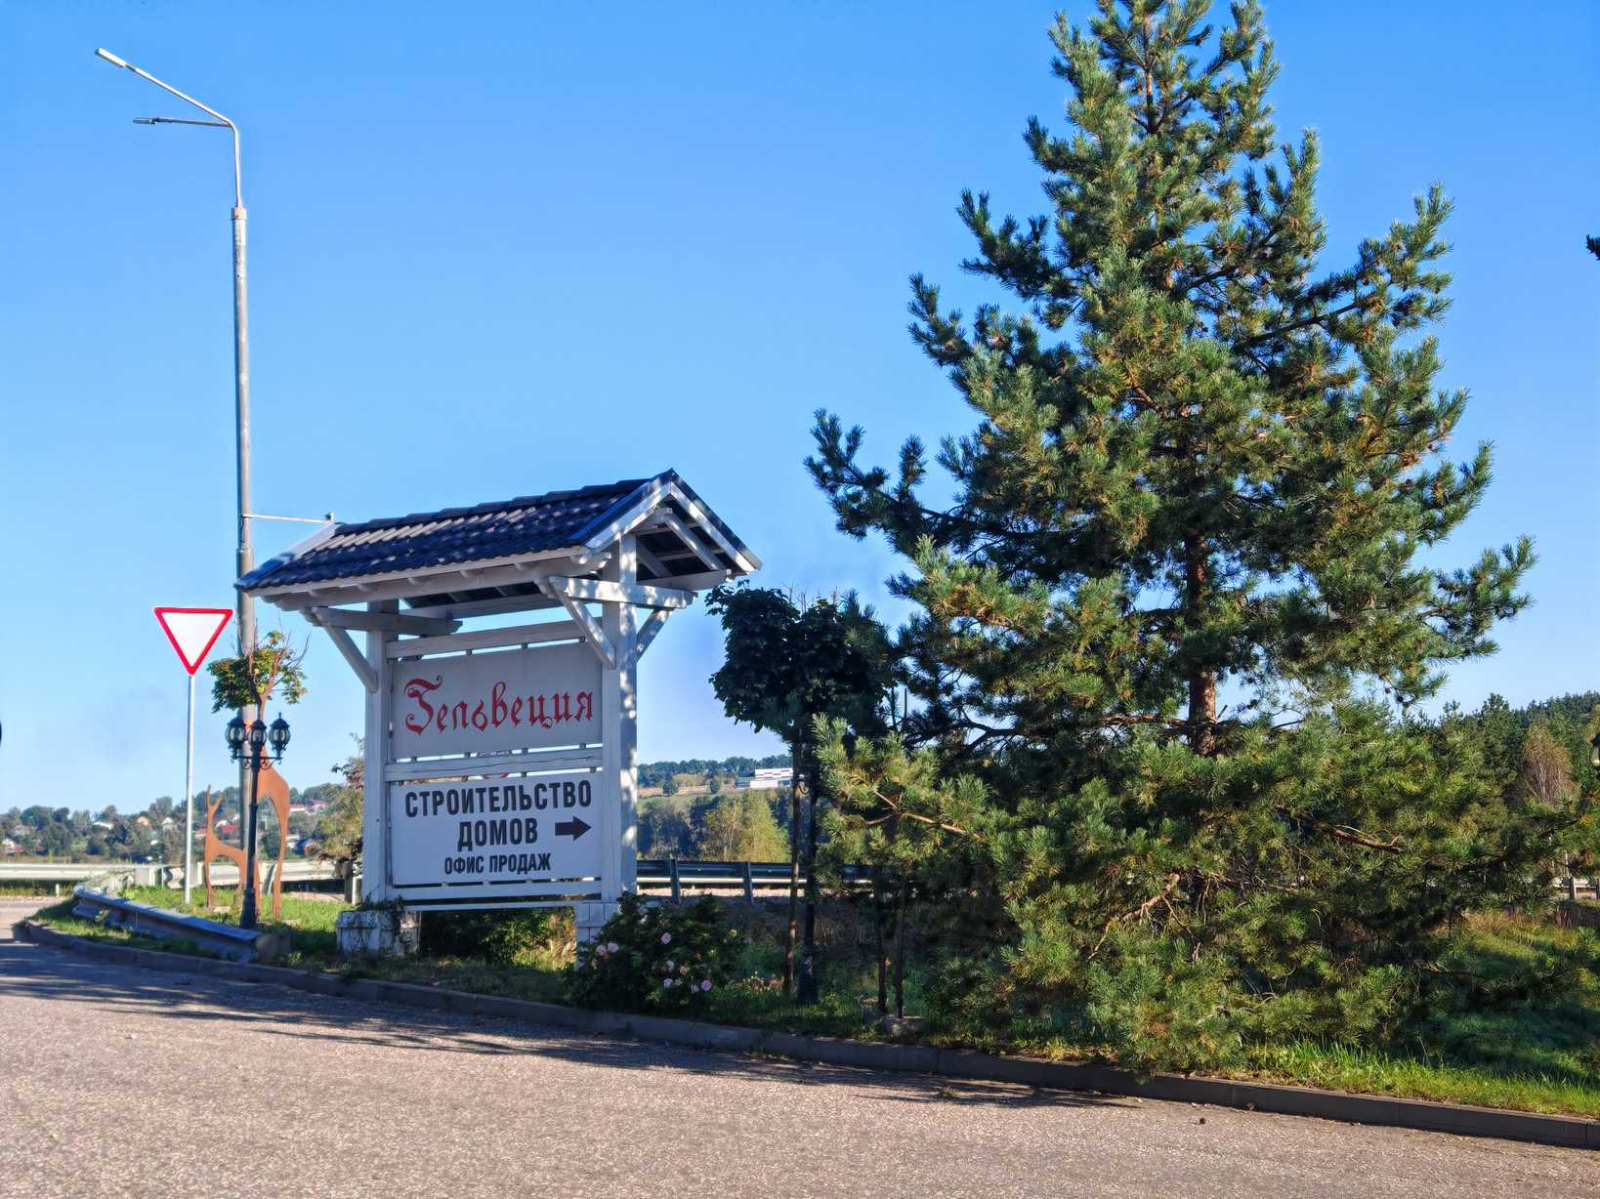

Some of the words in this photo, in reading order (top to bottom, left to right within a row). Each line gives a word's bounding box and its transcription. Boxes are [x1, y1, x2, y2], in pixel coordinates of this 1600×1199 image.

[404, 675, 594, 735] Гельвеция
[405, 780, 592, 818] СТРОИТЕЛЬСТВО
[457, 817, 538, 851] ДОМОВ
[444, 855, 484, 875] ОФИС
[489, 852, 552, 875] ПРОДАЖ
